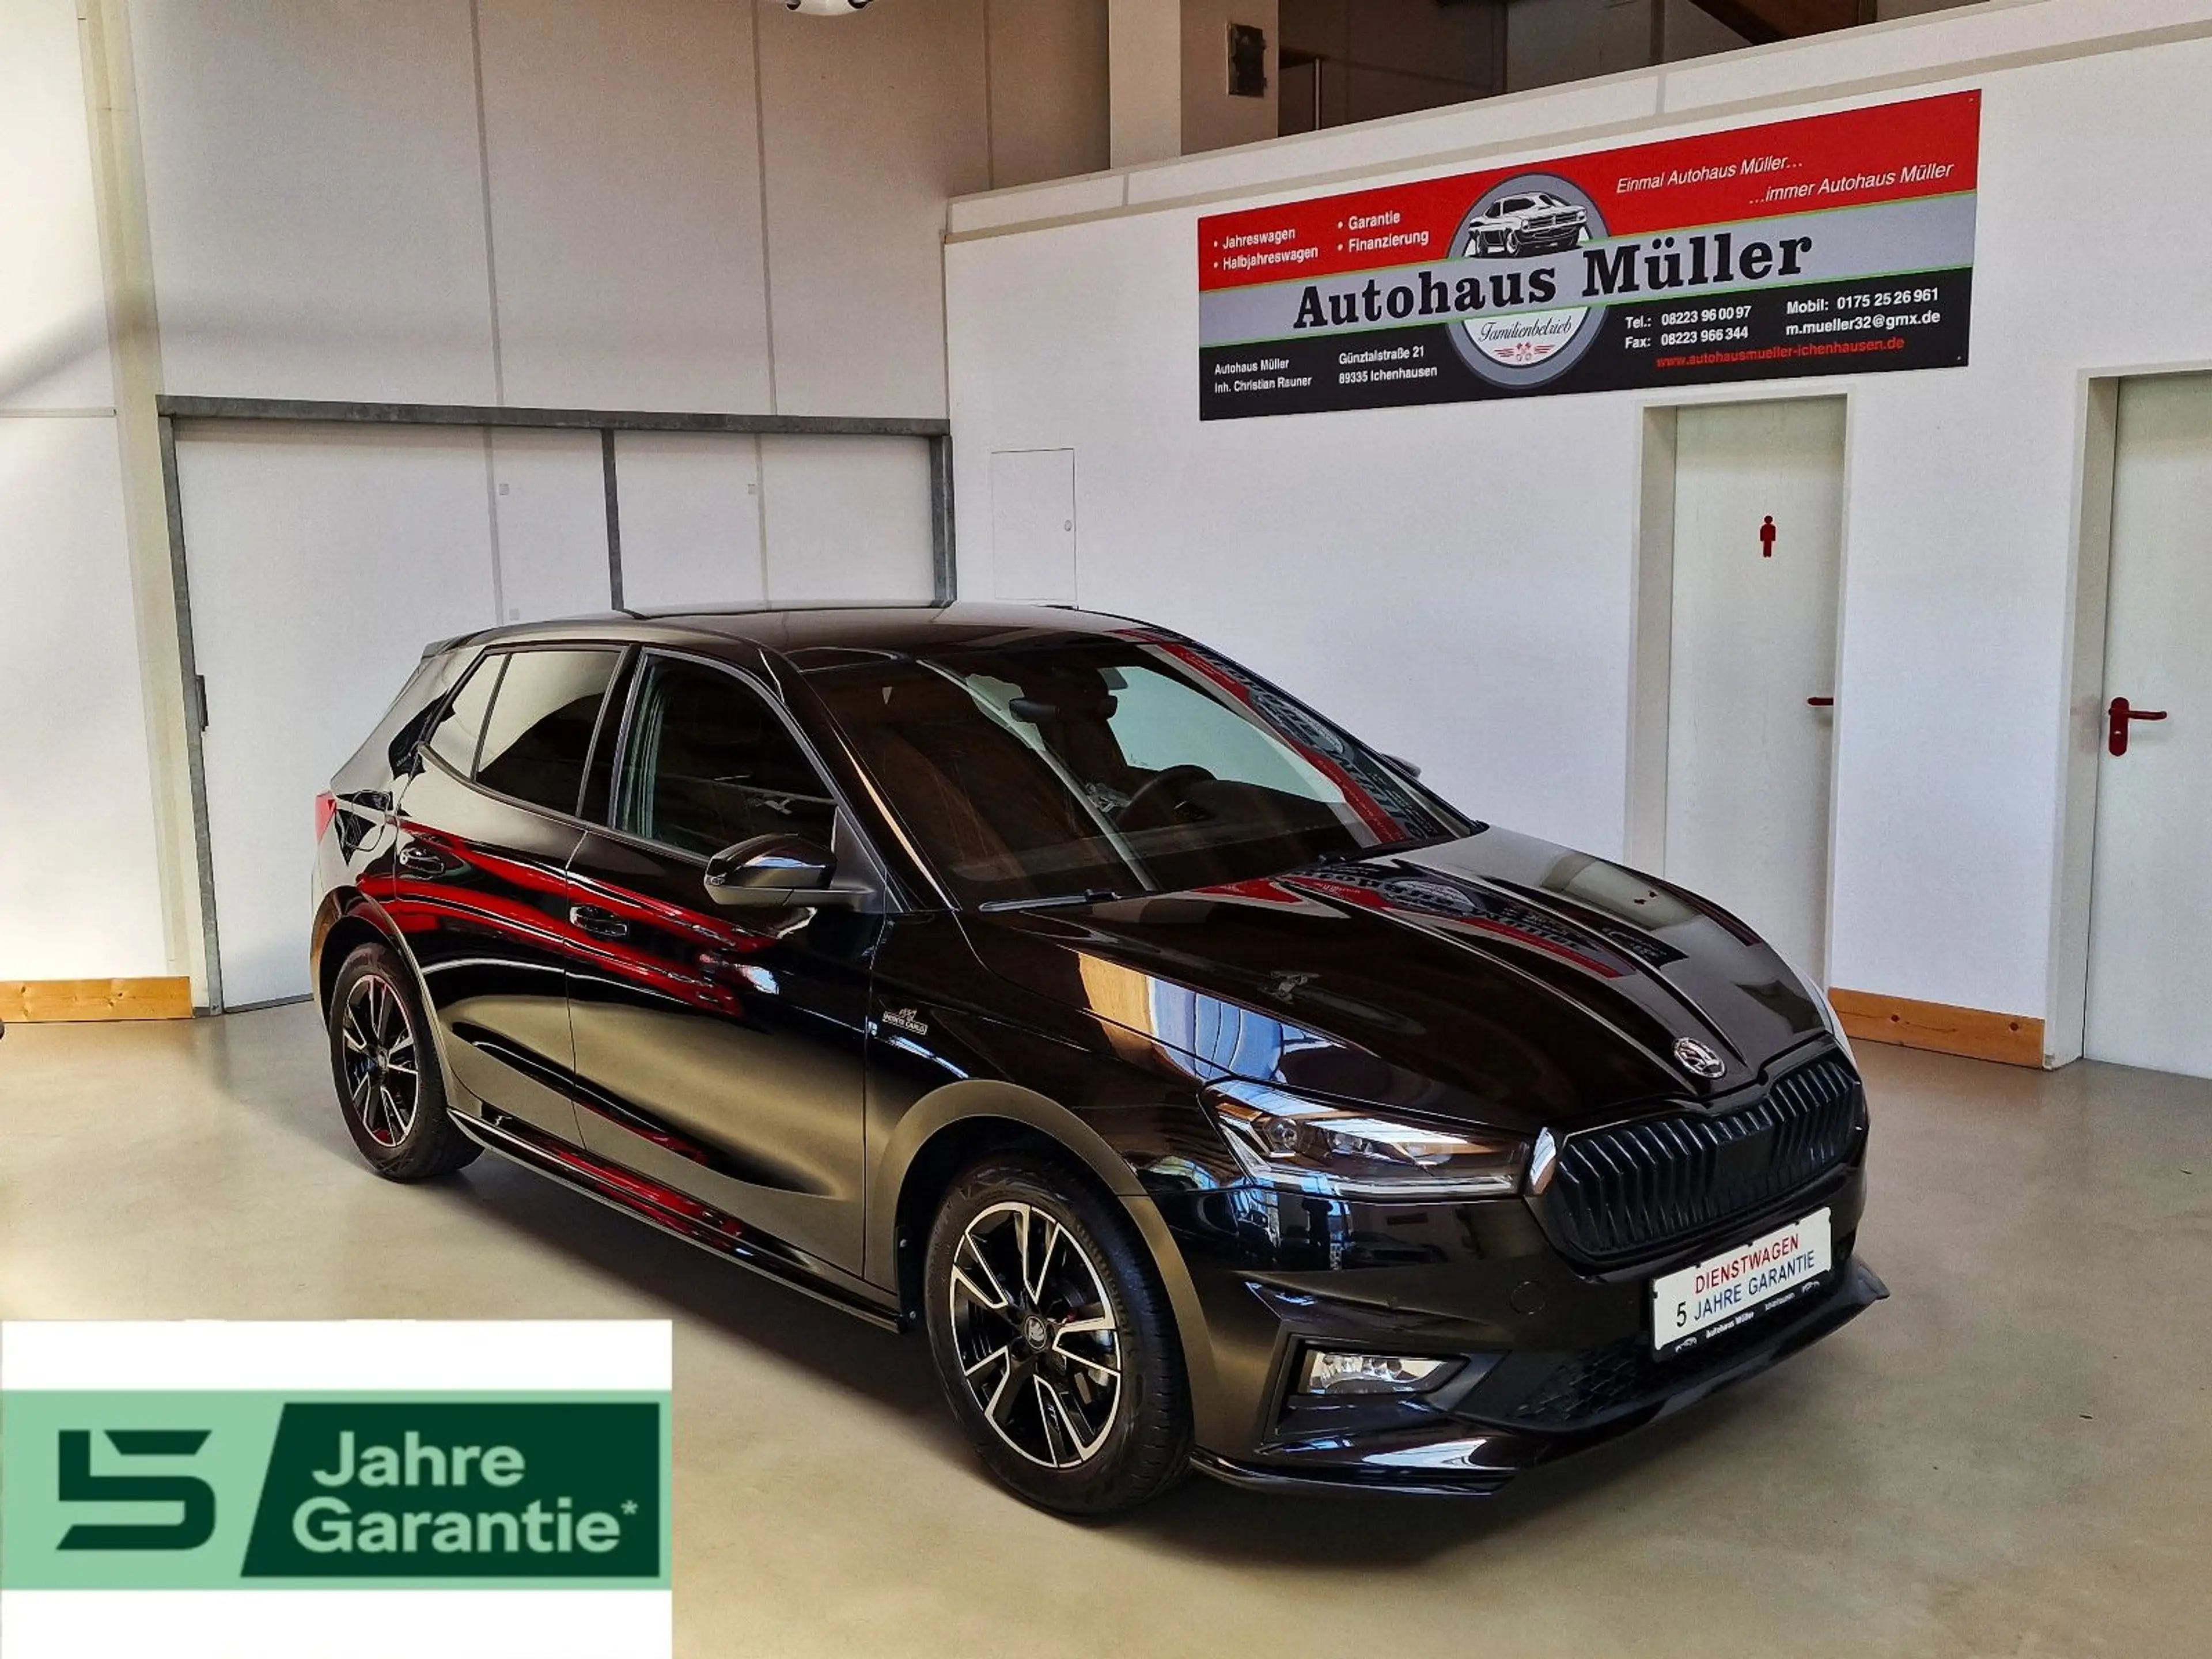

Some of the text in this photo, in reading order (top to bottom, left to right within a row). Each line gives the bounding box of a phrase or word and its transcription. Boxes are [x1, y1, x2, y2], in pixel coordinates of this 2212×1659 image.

[1616, 155, 1803, 194] Einmal Autohaus Müller...
[1749, 163, 1955, 204] ...immer Autohaus Müller
[1349, 210, 1400, 230] Garantie
[1222, 229, 1296, 249] Jahreswagen
[1349, 230, 1429, 252] Finanzierung
[1222, 246, 1319, 271] Halbjahreswagen
[1293, 232, 1812, 329] Autohaus Müller
[1786, 298, 1829, 315] Mobil:
[1836, 294, 1871, 310] 0175
[1913, 287, 1938, 302] 961
[1478, 315, 1571, 342] Familienbetrieb
[1625, 315, 1652, 329] Tel.:
[1661, 310, 1699, 326] 08223
[1786, 309, 1941, 336] m.mueller32@gmx.de
[1625, 336, 1652, 350] Fax:
[1661, 331, 1698, 347] 08223
[1656, 337, 1905, 368] www.autohausmueller-ichenhausen.de
[1214, 358, 1290, 376] Autohaus Müller
[1338, 345, 1424, 365] Günztalstraße 21
[1214, 381, 1232, 393] Inh.
[1234, 378, 1275, 392] Christian
[1338, 366, 1438, 384] 89335 Ichenhausen
[1695, 1233, 1800, 1295] DIENSTWAGEN
[1676, 1249, 1815, 1328] 5 JAHRE GARANTIE
